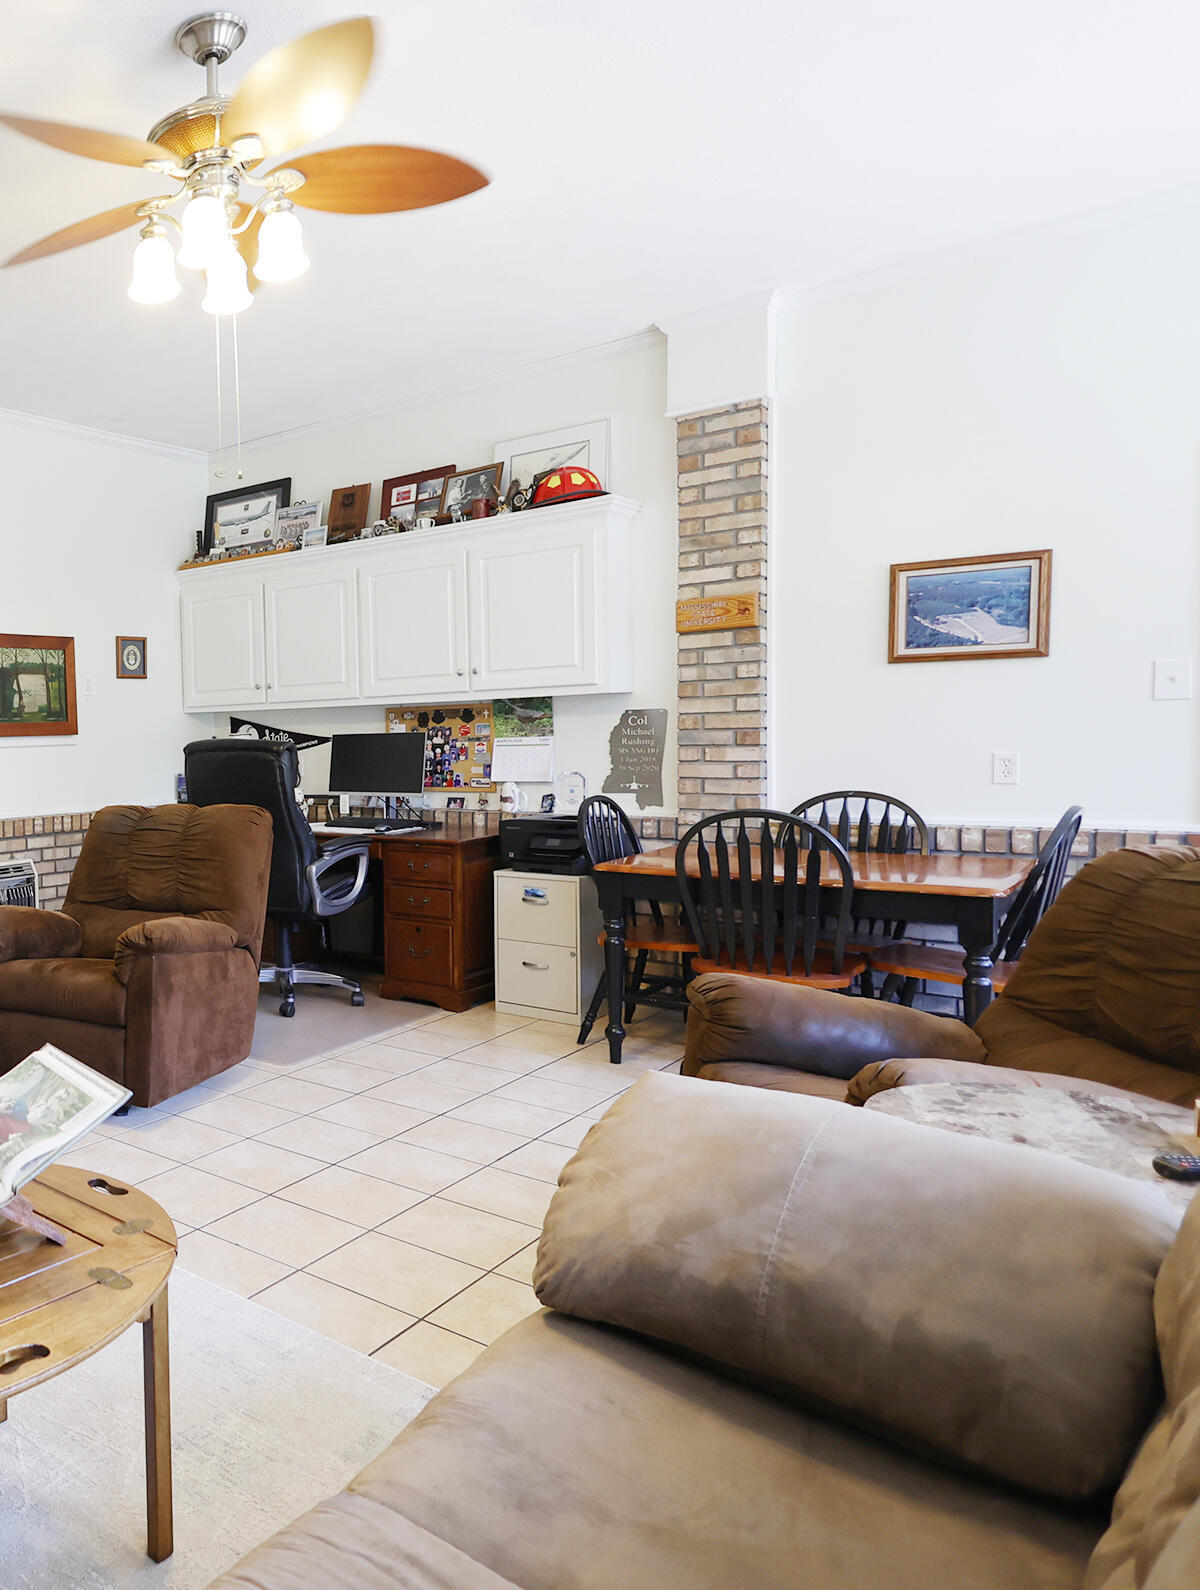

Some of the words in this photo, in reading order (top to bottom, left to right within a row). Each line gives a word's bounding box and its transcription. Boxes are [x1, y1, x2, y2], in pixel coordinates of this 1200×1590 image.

[692, 609, 716, 618] STATE
[681, 616, 728, 628] UNIVERSITY
[628, 715, 648, 726] Col
[621, 727, 655, 736] Michael
[621, 738, 656, 747] Rushing
